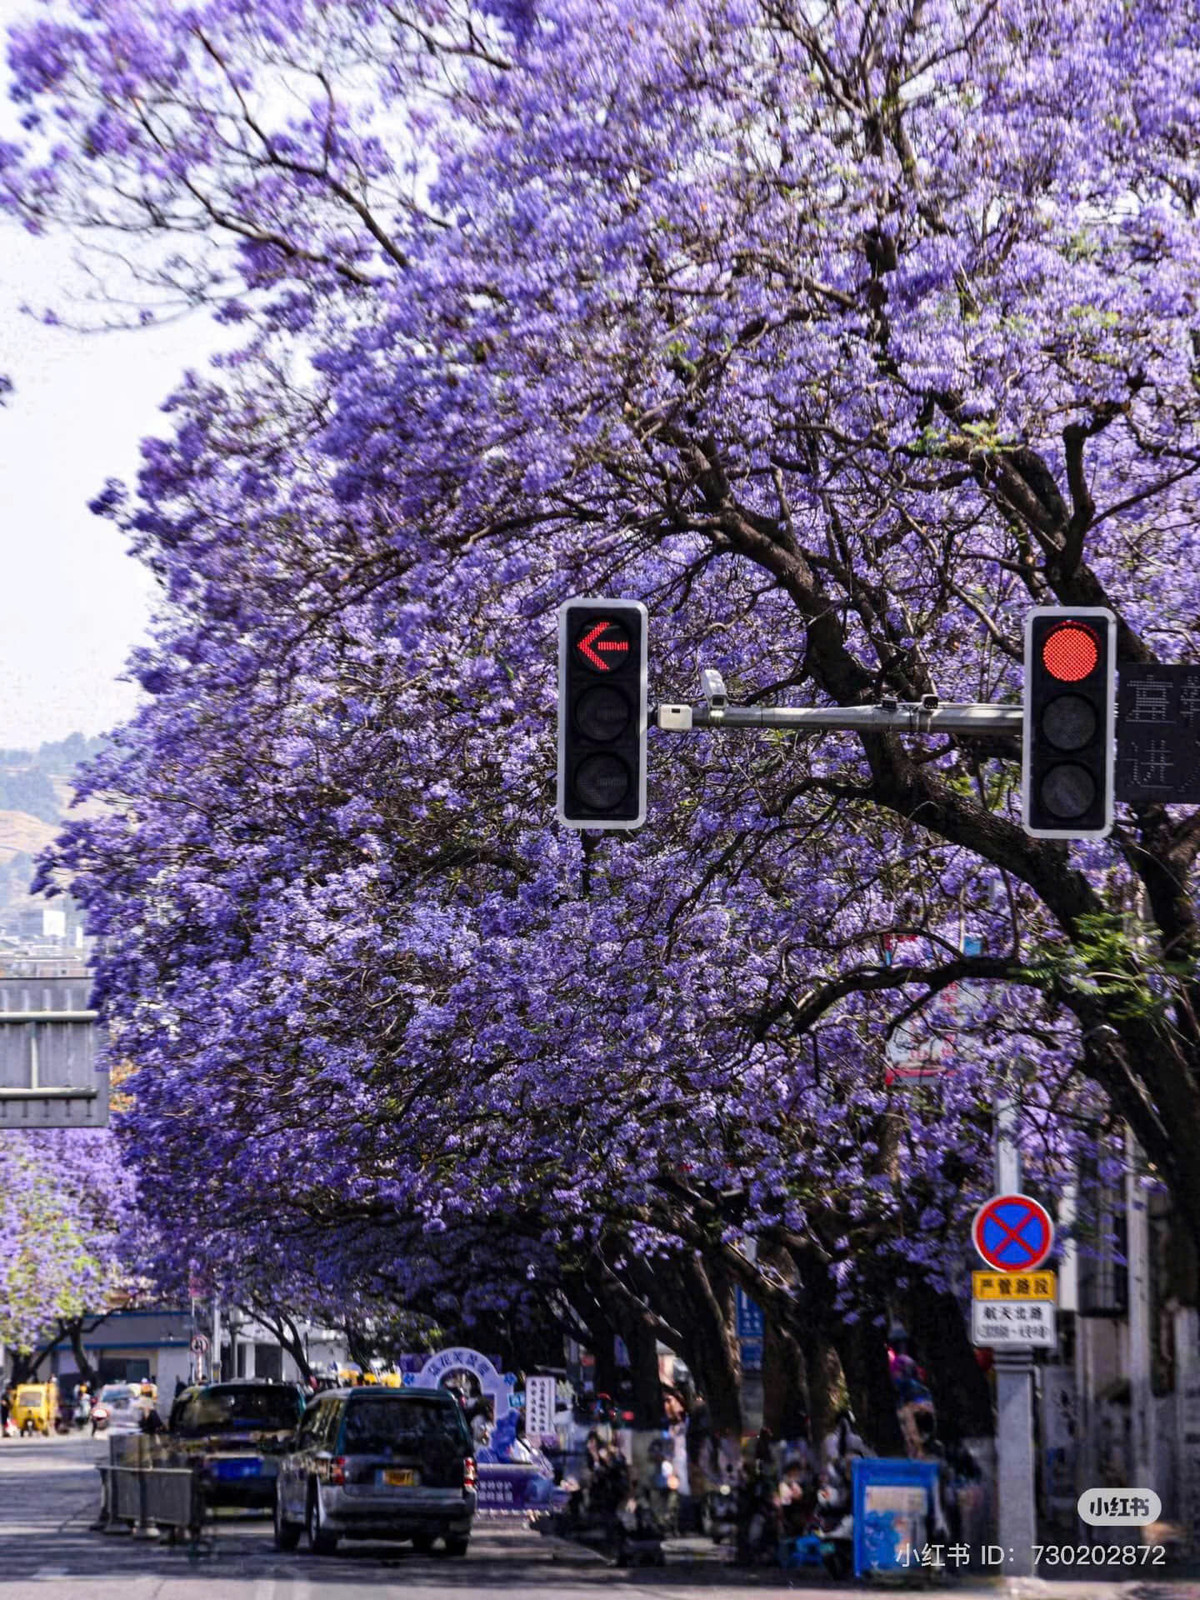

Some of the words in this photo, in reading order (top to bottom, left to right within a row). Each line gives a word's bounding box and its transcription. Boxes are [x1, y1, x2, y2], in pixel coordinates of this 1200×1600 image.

[979, 1278, 1049, 1296] 严管路段
[983, 1306, 1043, 1321] 航天北路
